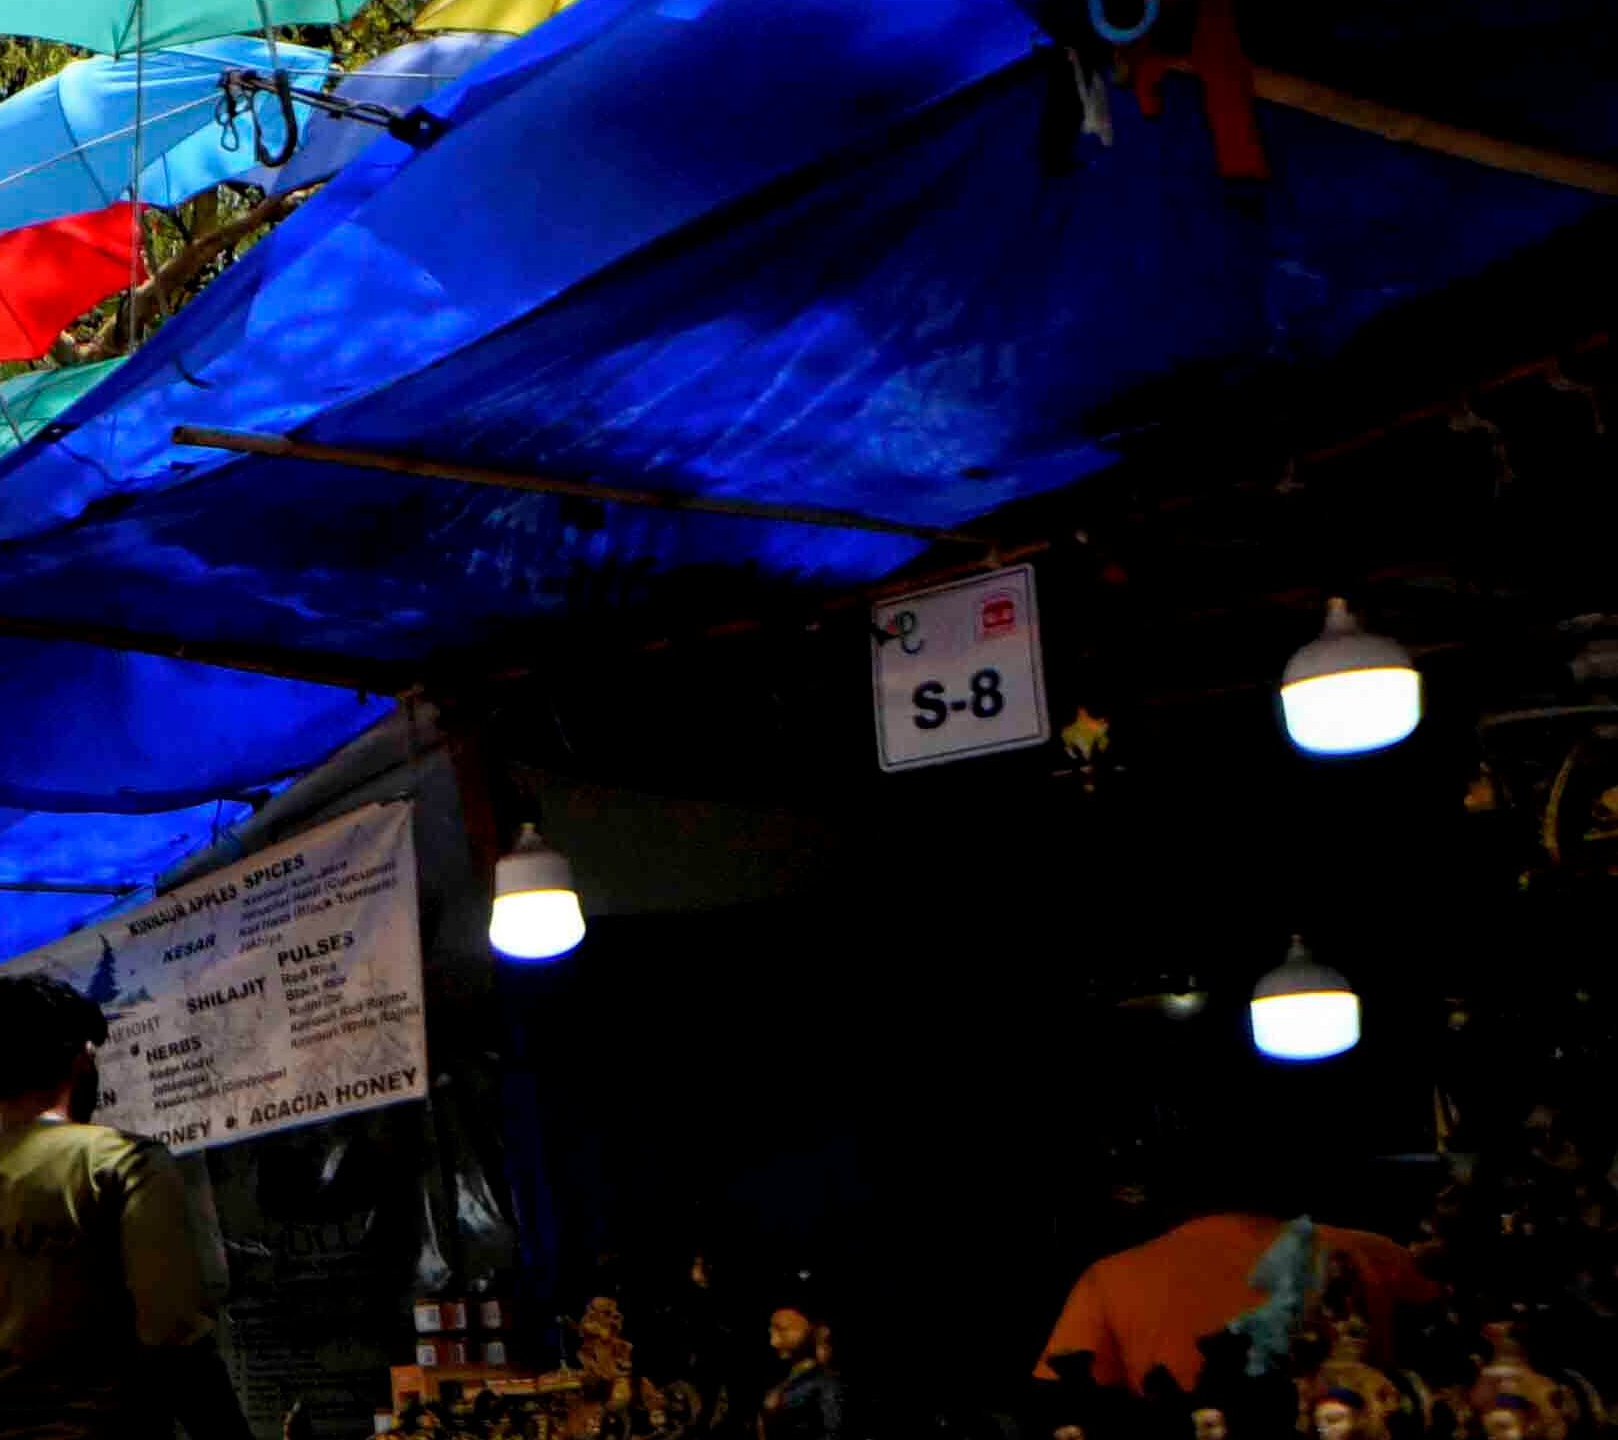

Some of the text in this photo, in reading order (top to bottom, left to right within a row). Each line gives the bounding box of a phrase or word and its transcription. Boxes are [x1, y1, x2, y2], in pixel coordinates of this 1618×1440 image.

[913, 667, 1004, 730] S-8
[243, 854, 305, 890] SPICES
[162, 934, 217, 963] KESAR
[277, 930, 355, 967] PULSES
[185, 977, 267, 1016] SHILAJIT
[146, 1036, 203, 1064] HERBS
[249, 1091, 330, 1126] ACACIA
[335, 1067, 417, 1105] HONEY
